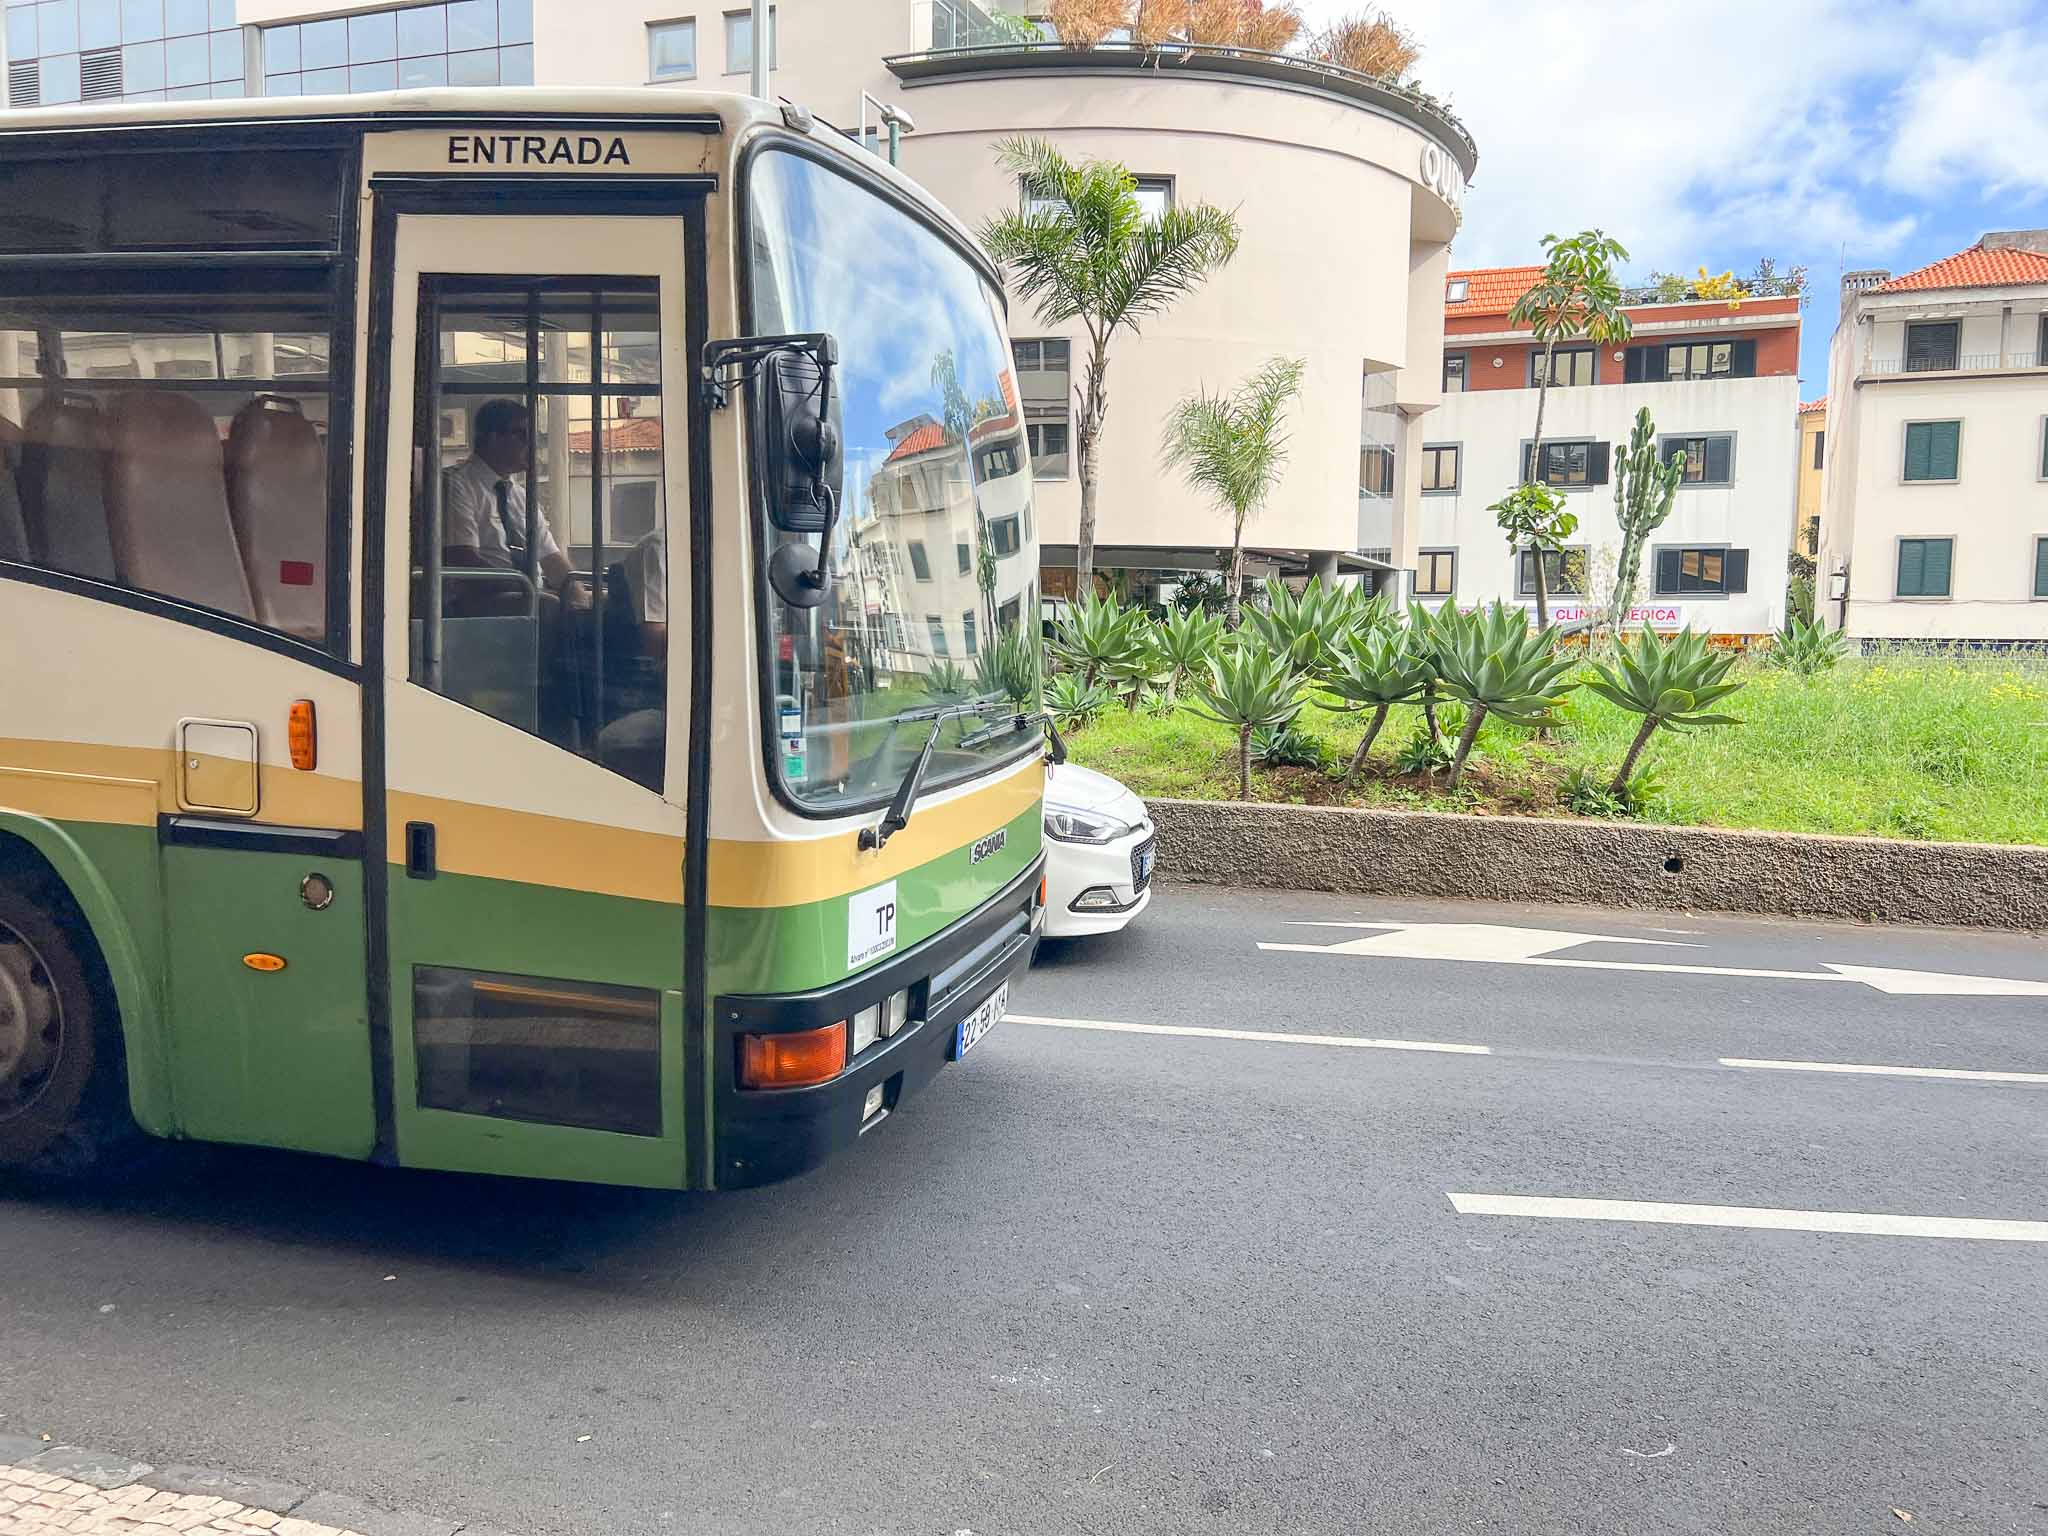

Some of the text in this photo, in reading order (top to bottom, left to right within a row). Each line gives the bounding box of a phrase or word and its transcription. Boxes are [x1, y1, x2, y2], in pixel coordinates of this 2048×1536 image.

[448, 136, 630, 165] ENTRADA
[973, 830, 1006, 863] SCANIA
[876, 902, 895, 936] TP
